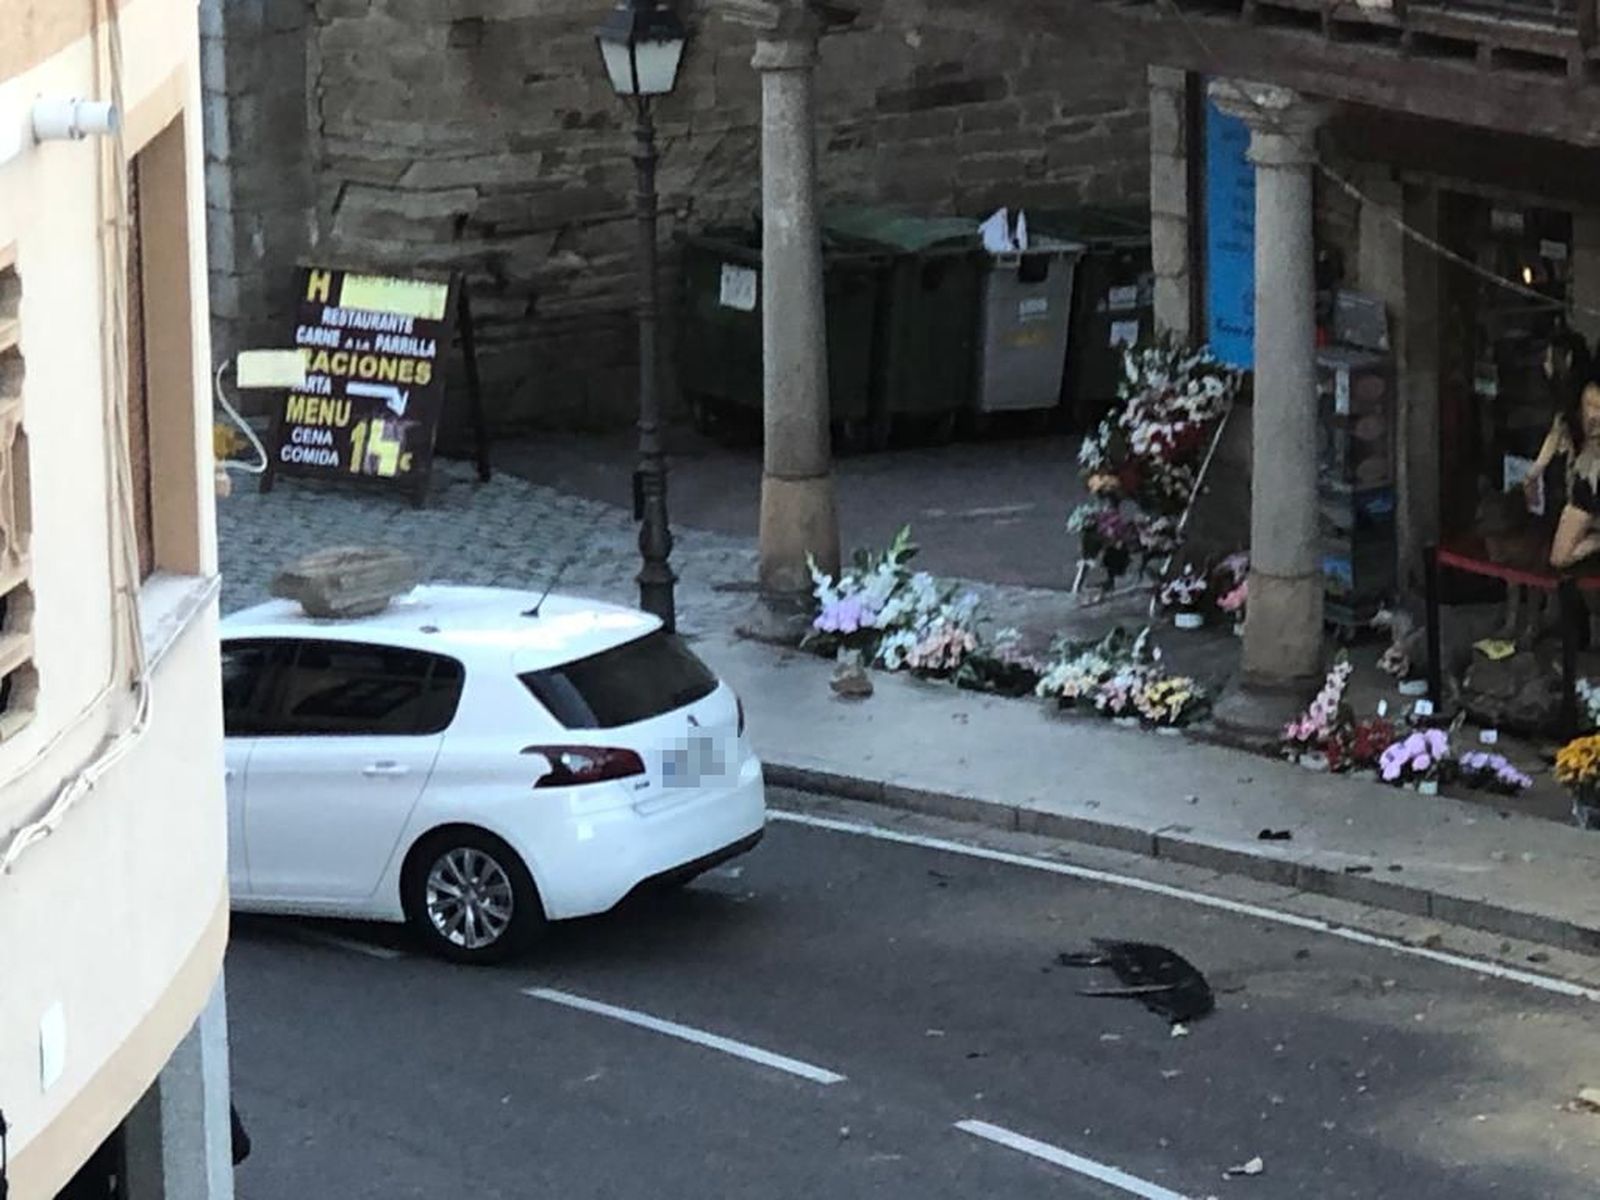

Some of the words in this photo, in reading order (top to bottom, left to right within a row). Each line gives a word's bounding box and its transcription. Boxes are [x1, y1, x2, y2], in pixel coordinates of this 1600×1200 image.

[321, 306, 415, 335] RESTAURANTE
[295, 325, 341, 348] CARNE
[344, 338, 354, 350] A
[374, 333, 437, 359] PARRILLA
[285, 394, 352, 428] MENU
[291, 425, 334, 446] CENA
[280, 444, 340, 467] COMIDA
